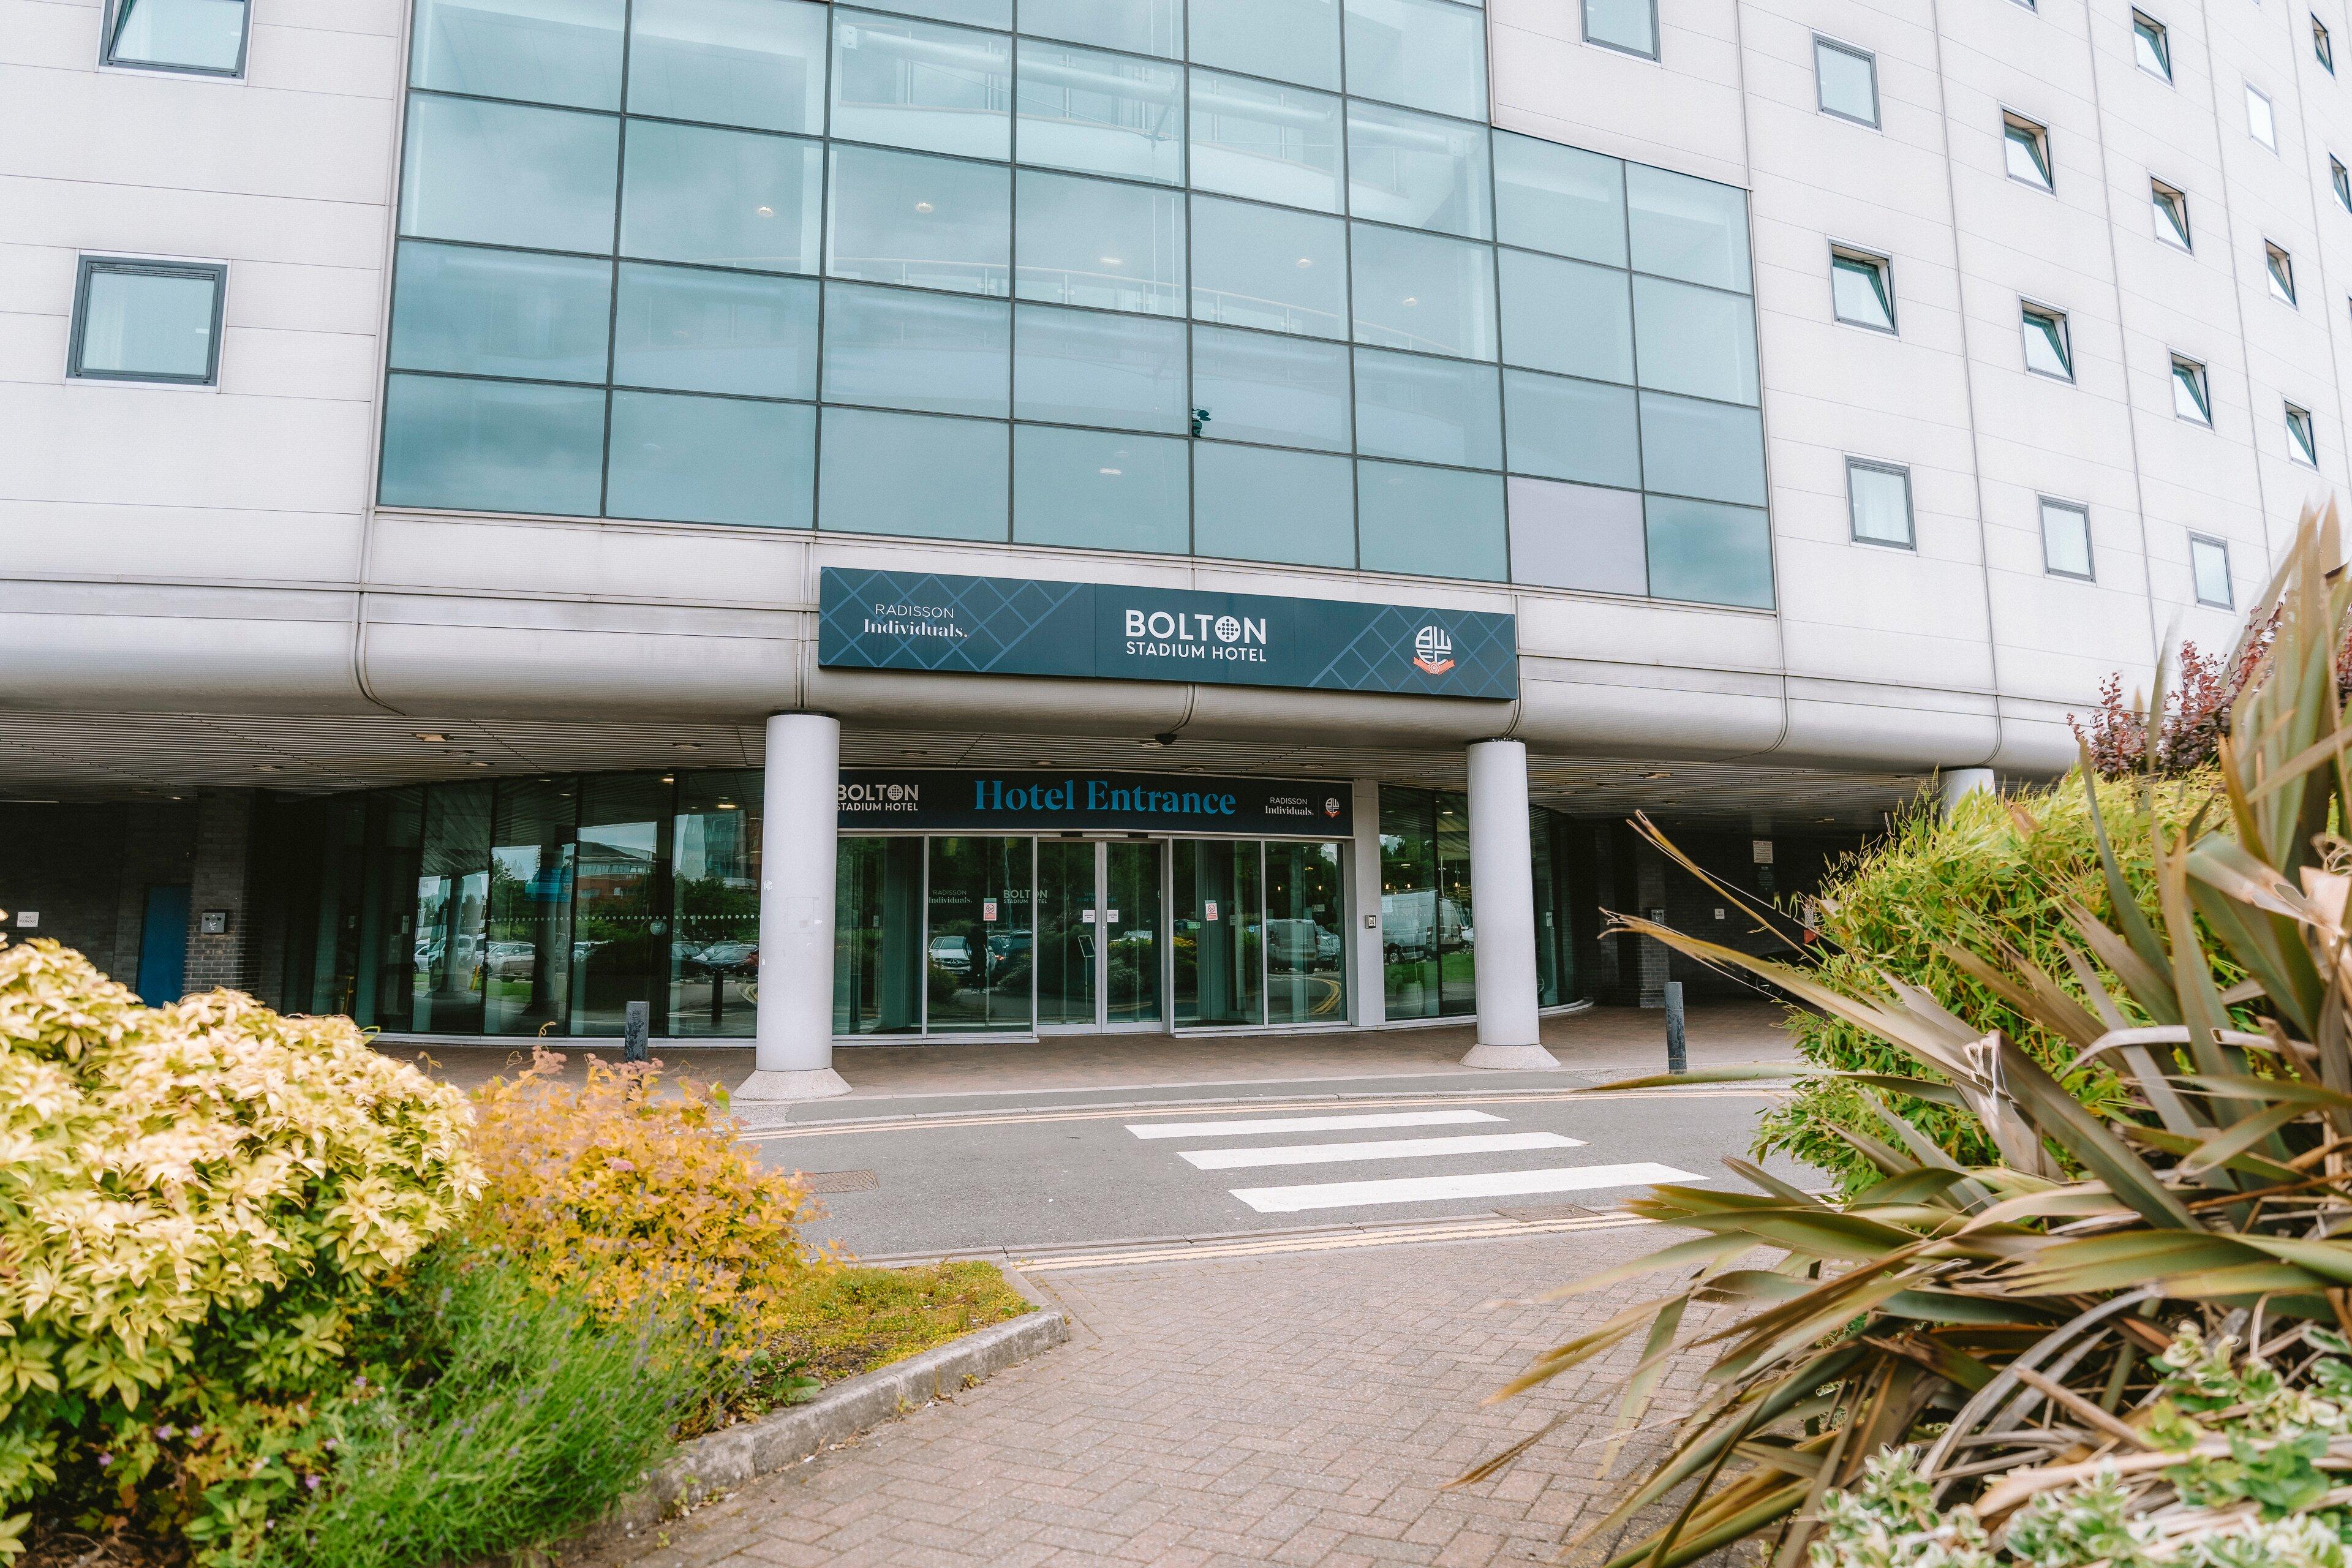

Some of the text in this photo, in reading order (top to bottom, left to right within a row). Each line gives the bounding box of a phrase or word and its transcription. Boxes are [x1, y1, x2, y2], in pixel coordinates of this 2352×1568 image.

[875, 604, 954, 619] RADISSON
[864, 619, 968, 638] Individuals.
[1125, 609, 1267, 644] BOLTON
[1126, 641, 1267, 662] STADIUM HOTEL
[974, 779, 1236, 815] Hotel Entrance
[885, 802, 918, 811] HOTEL
[1265, 805, 1314, 815] Individuals.
[1003, 889, 1047, 899] BOLTN
